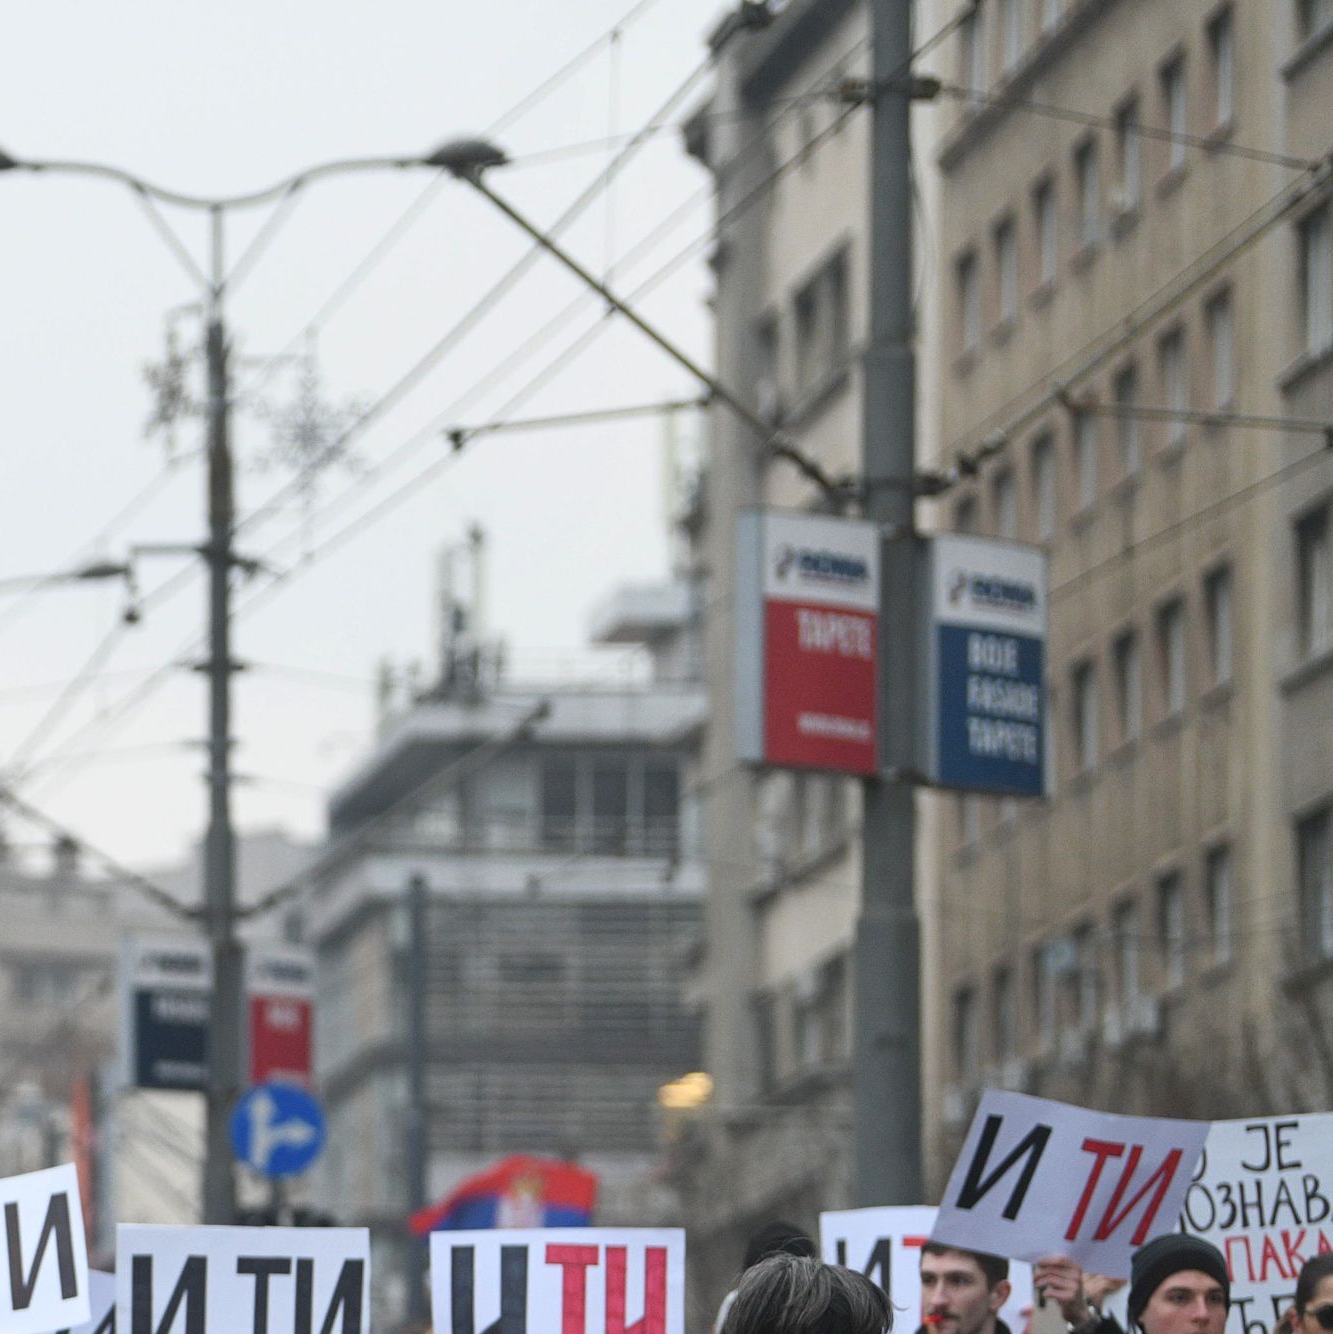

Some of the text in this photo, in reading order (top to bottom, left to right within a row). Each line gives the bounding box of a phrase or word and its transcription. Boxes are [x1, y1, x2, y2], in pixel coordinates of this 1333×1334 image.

[956, 1114, 1183, 1246] И ТИ
[1179, 1174, 1333, 1232] ОЗНАВ
